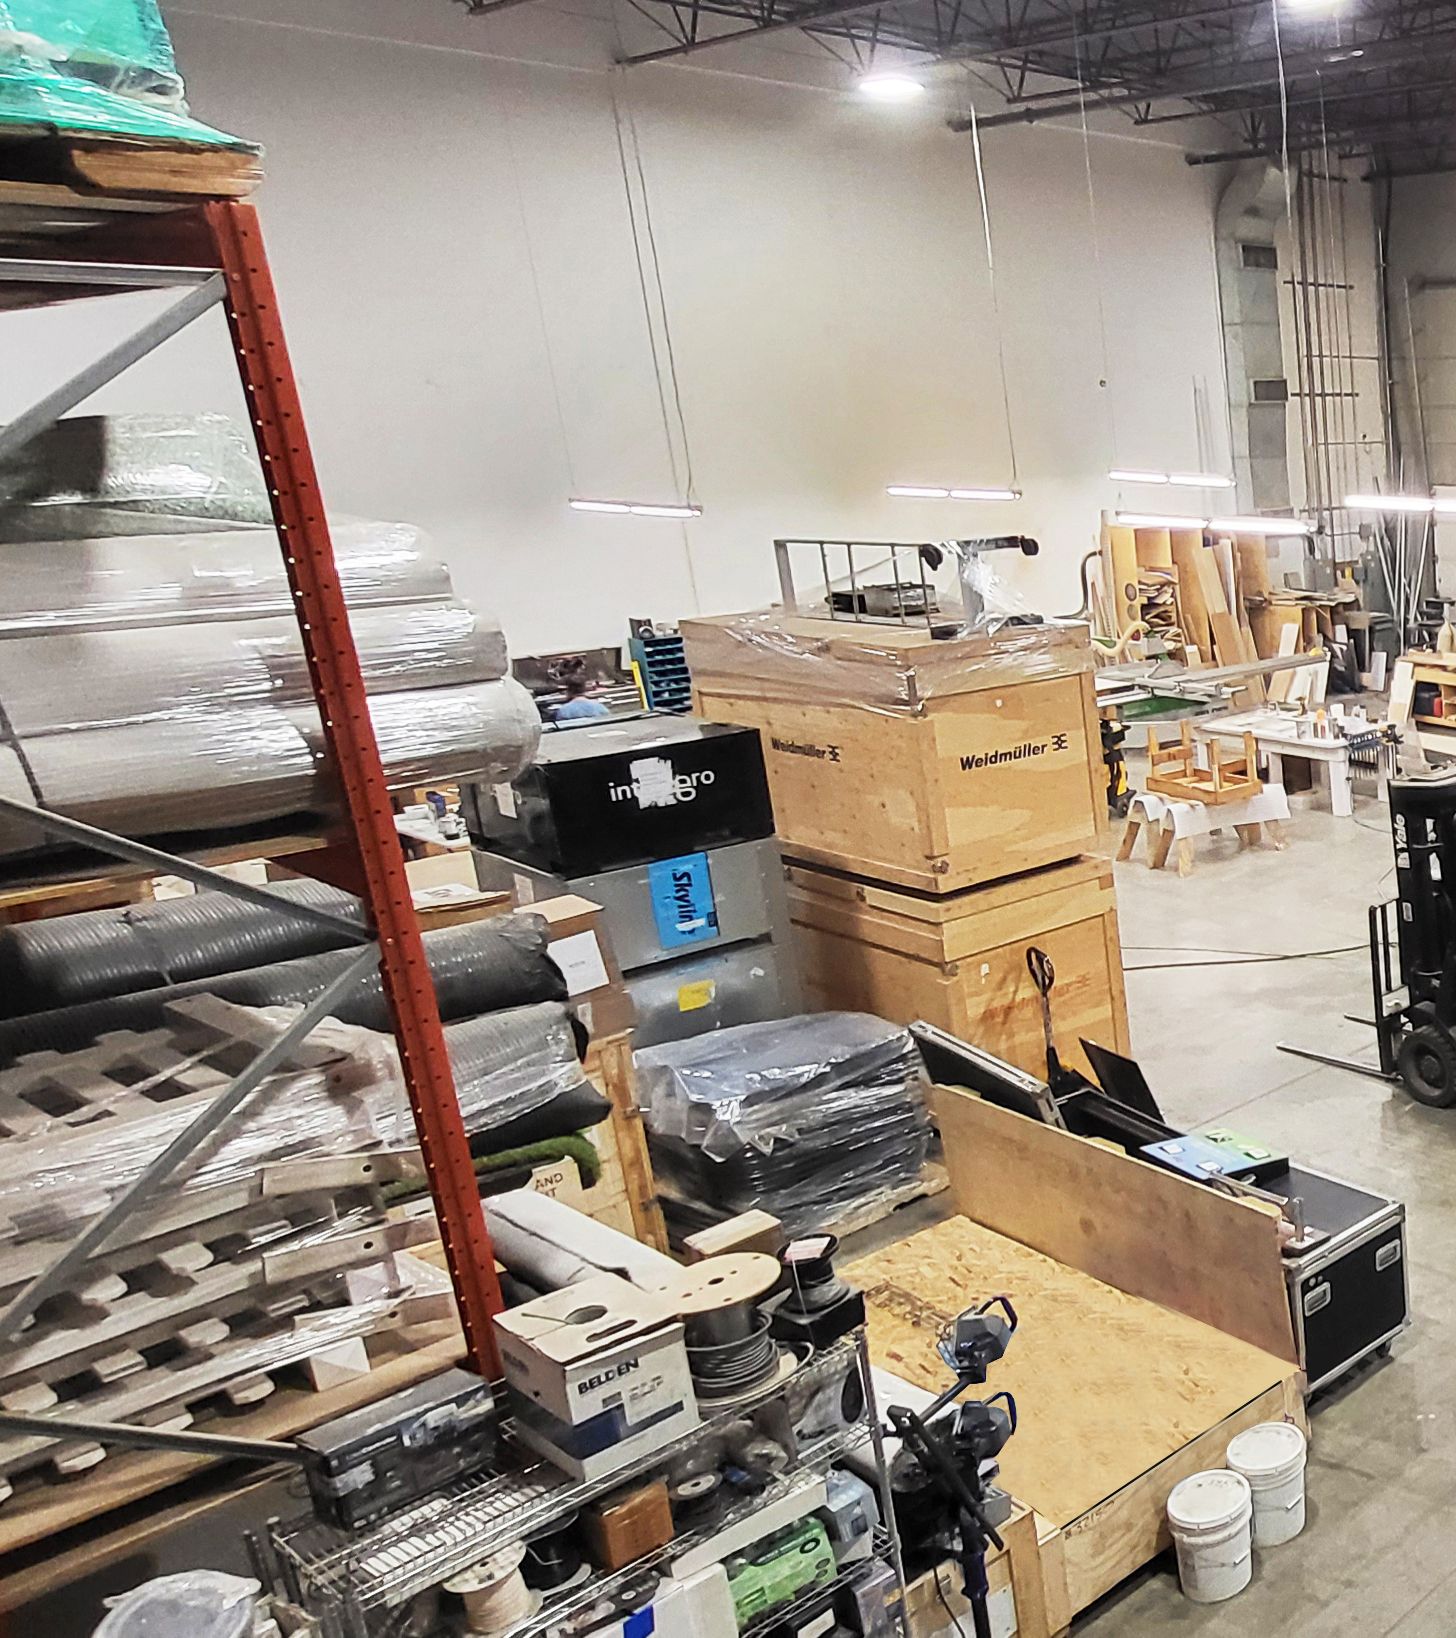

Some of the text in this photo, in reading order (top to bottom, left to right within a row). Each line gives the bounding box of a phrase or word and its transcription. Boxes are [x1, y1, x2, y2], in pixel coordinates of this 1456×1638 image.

[960, 742, 1048, 771] Weidmüller
[1393, 813, 1408, 850] Yale
[577, 1357, 639, 1395] BELDEN
